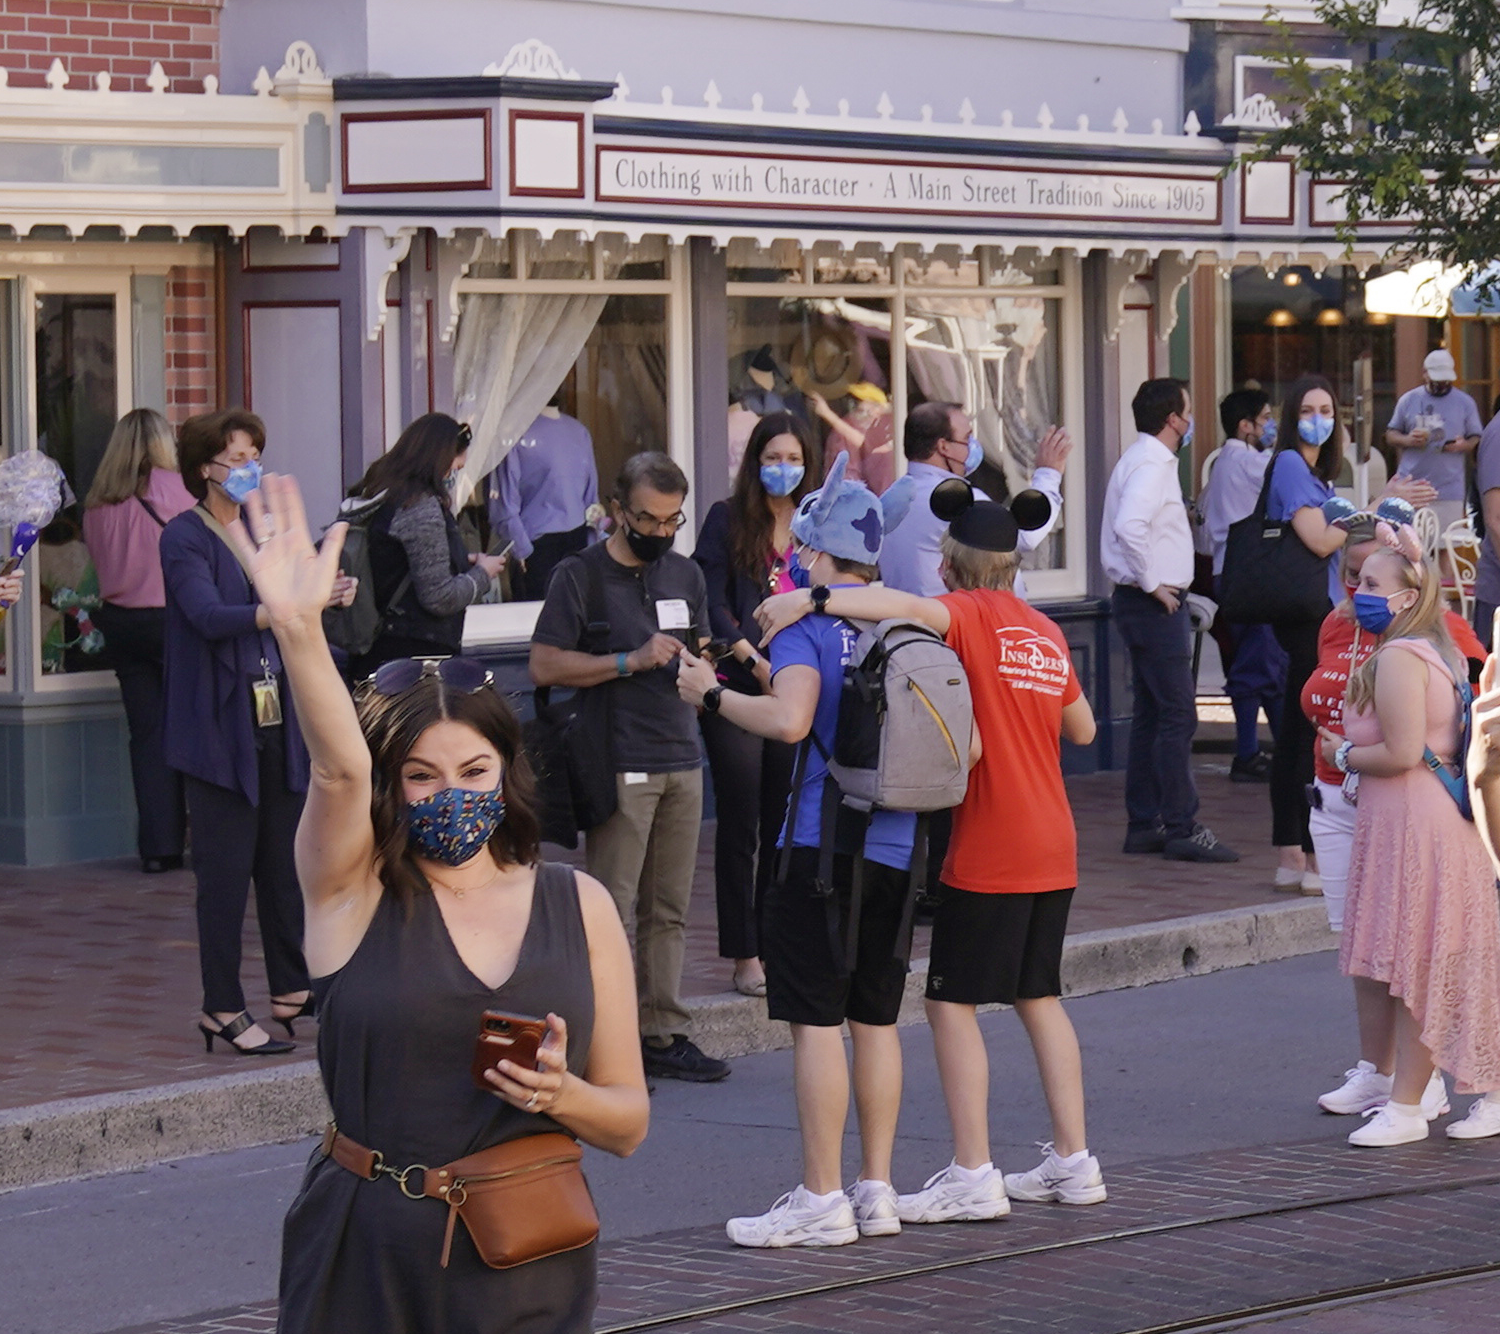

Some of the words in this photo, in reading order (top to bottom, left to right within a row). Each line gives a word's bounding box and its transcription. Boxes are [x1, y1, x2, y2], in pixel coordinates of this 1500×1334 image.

[615, 158, 701, 196] Clothing
[712, 166, 753, 192] with
[764, 166, 859, 197] Character
[884, 172, 897, 198] A
[908, 173, 952, 201] Main
[963, 176, 1017, 204] Street
[1026, 178, 1103, 208] Tradition
[1113, 183, 1157, 210] Since
[1166, 185, 1206, 212] 1905
